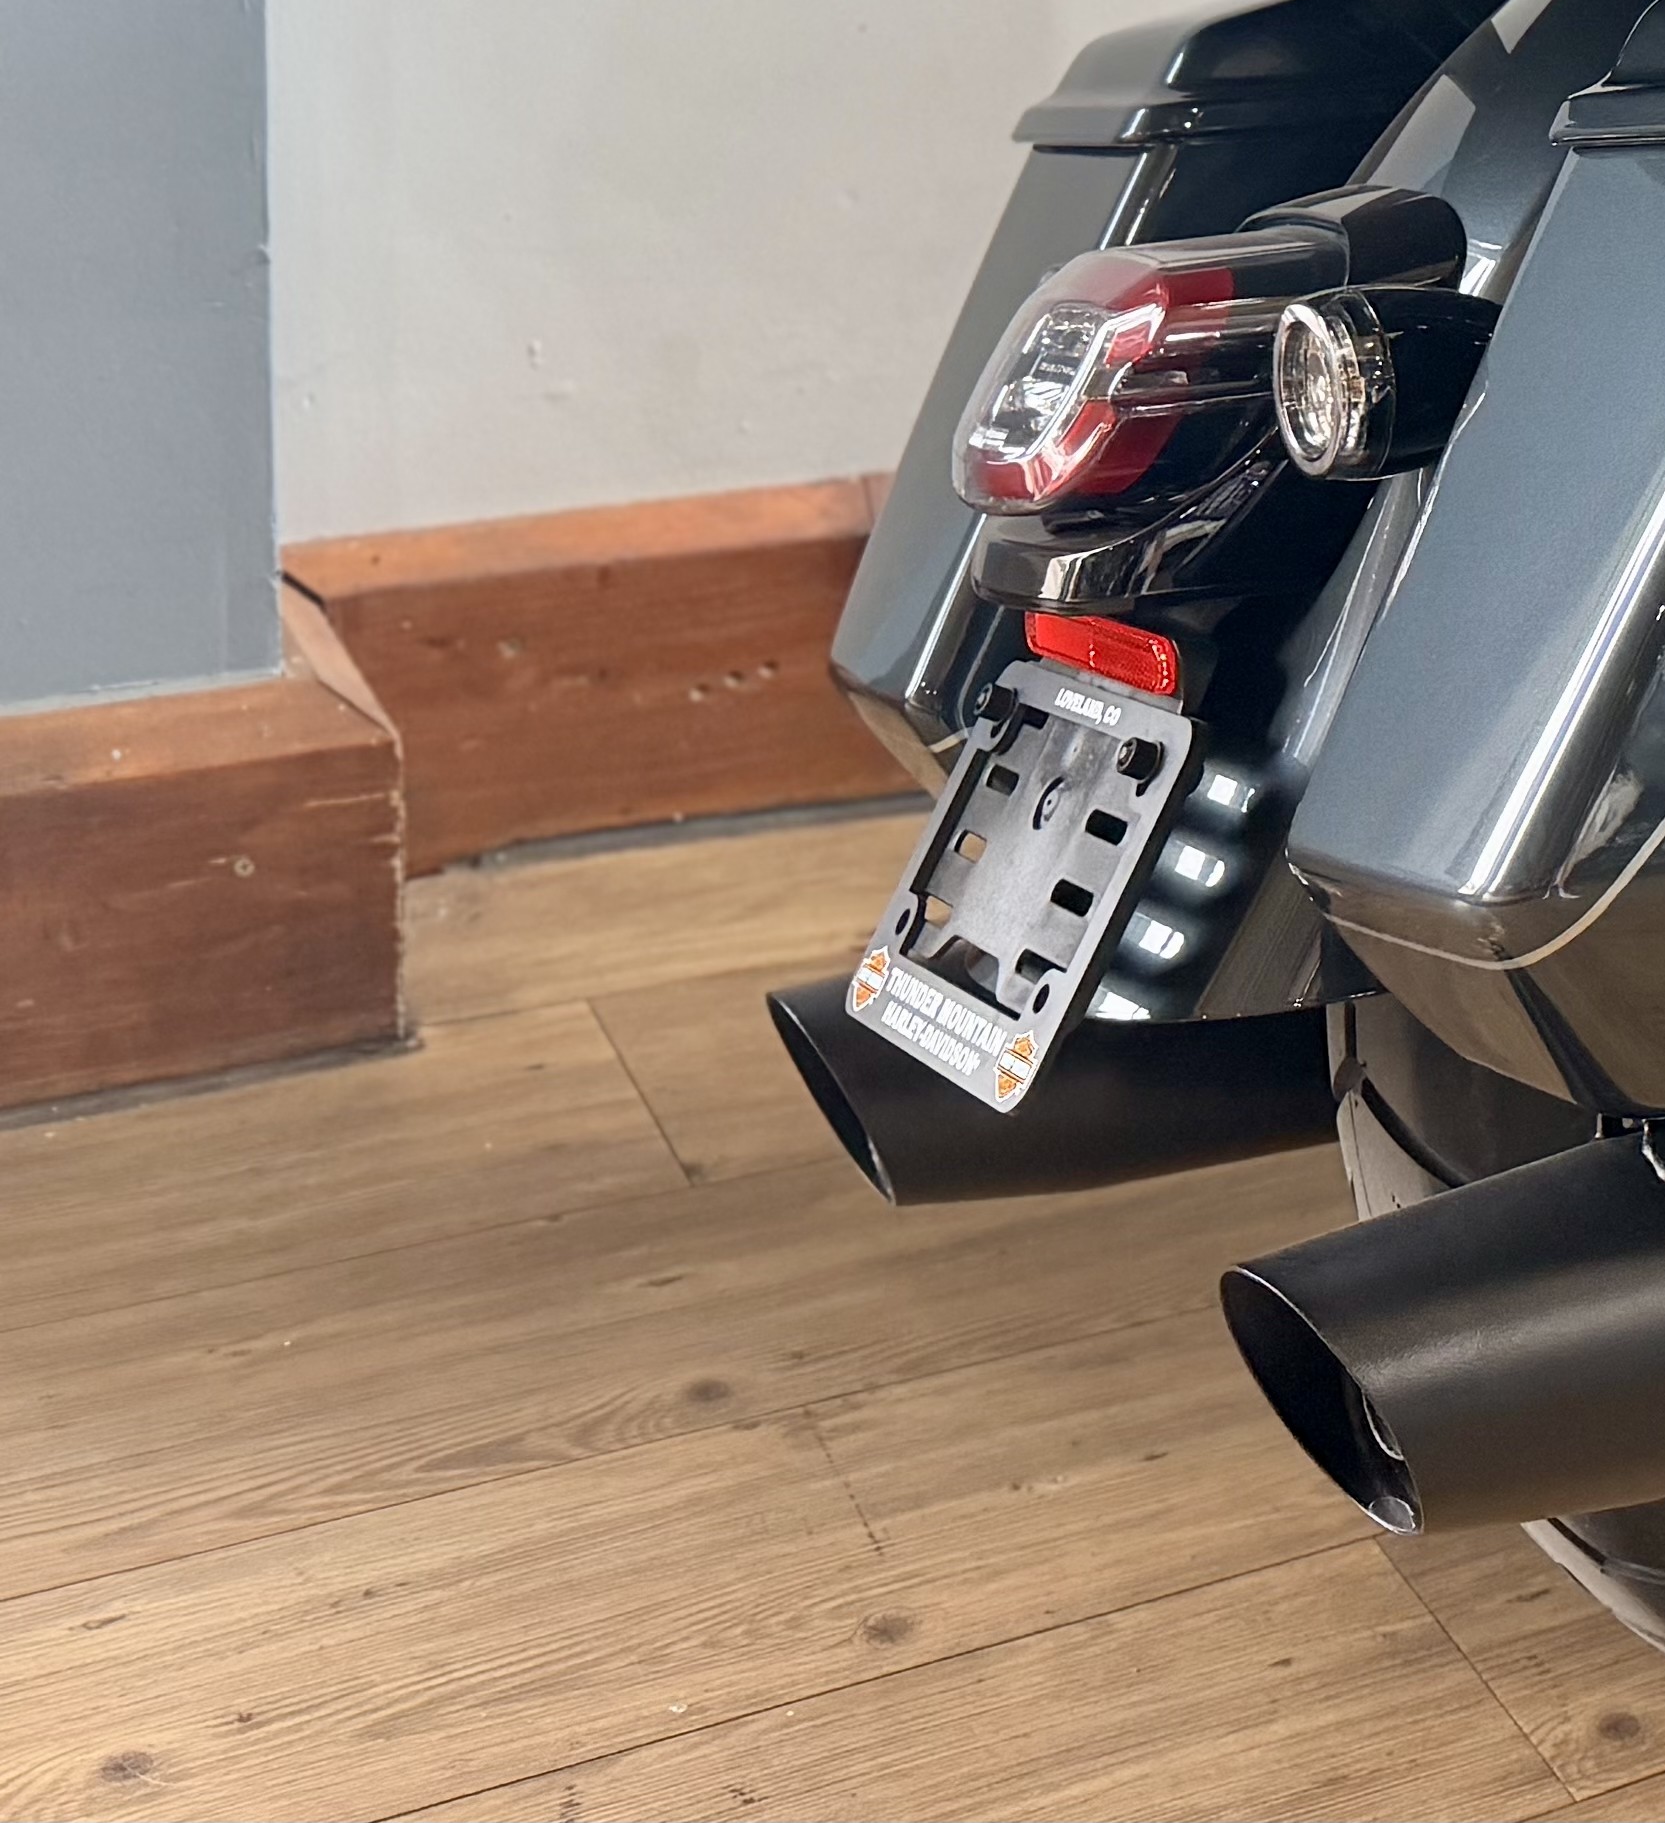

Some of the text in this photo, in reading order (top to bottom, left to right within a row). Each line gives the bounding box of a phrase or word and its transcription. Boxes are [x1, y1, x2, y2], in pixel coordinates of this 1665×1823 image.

[1102, 705, 1122, 726] CO
[885, 966, 944, 1020] THUNDER
[935, 998, 1008, 1058] MOUNTAIN
